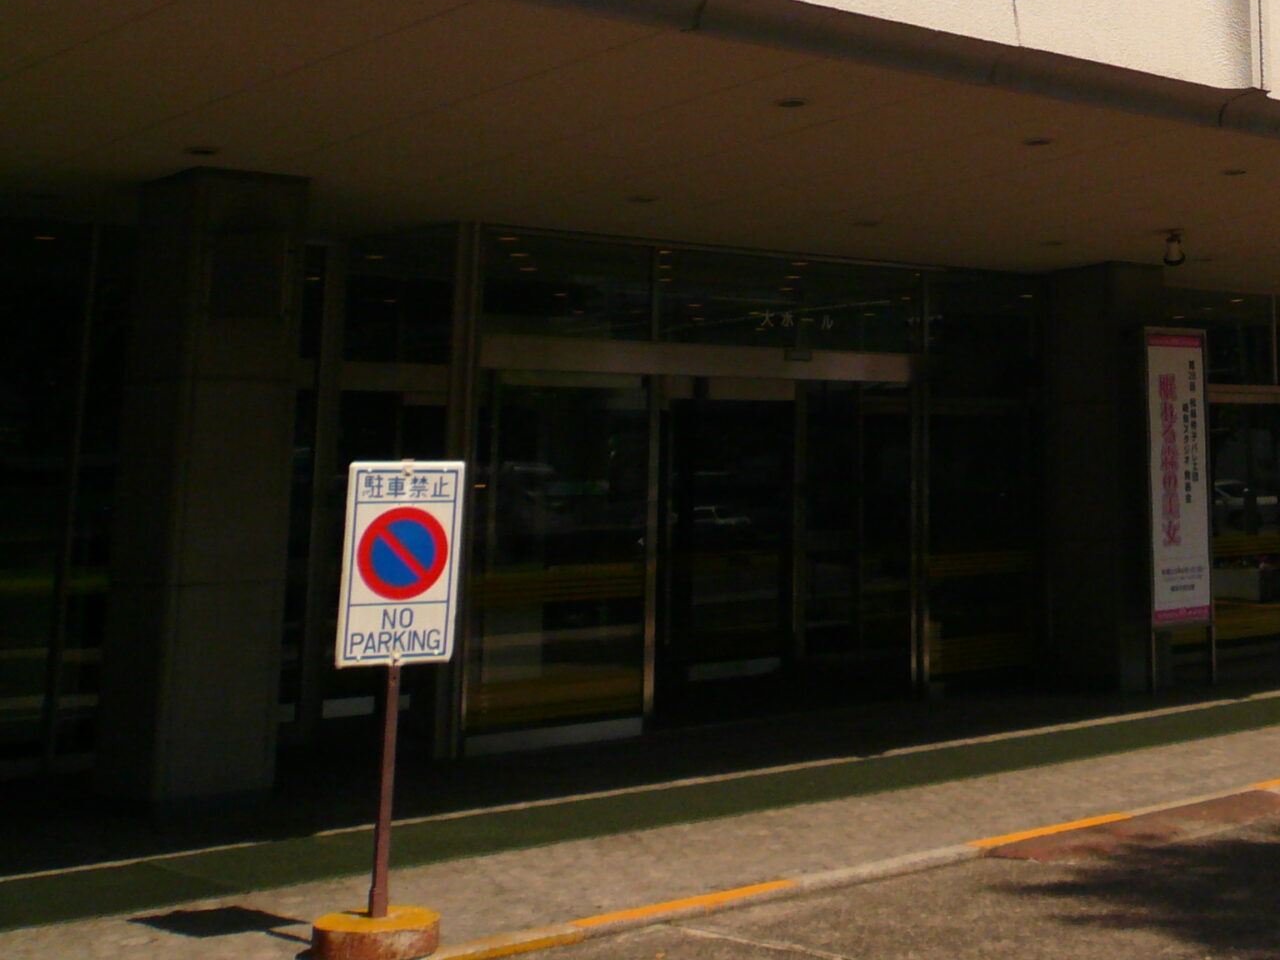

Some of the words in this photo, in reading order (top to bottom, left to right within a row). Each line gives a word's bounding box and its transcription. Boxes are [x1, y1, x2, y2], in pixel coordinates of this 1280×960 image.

[760, 310, 834, 330] 大ホール
[362, 475, 450, 498] 駐車禁止
[381, 607, 414, 629] NO
[350, 629, 441, 654] PARKING
